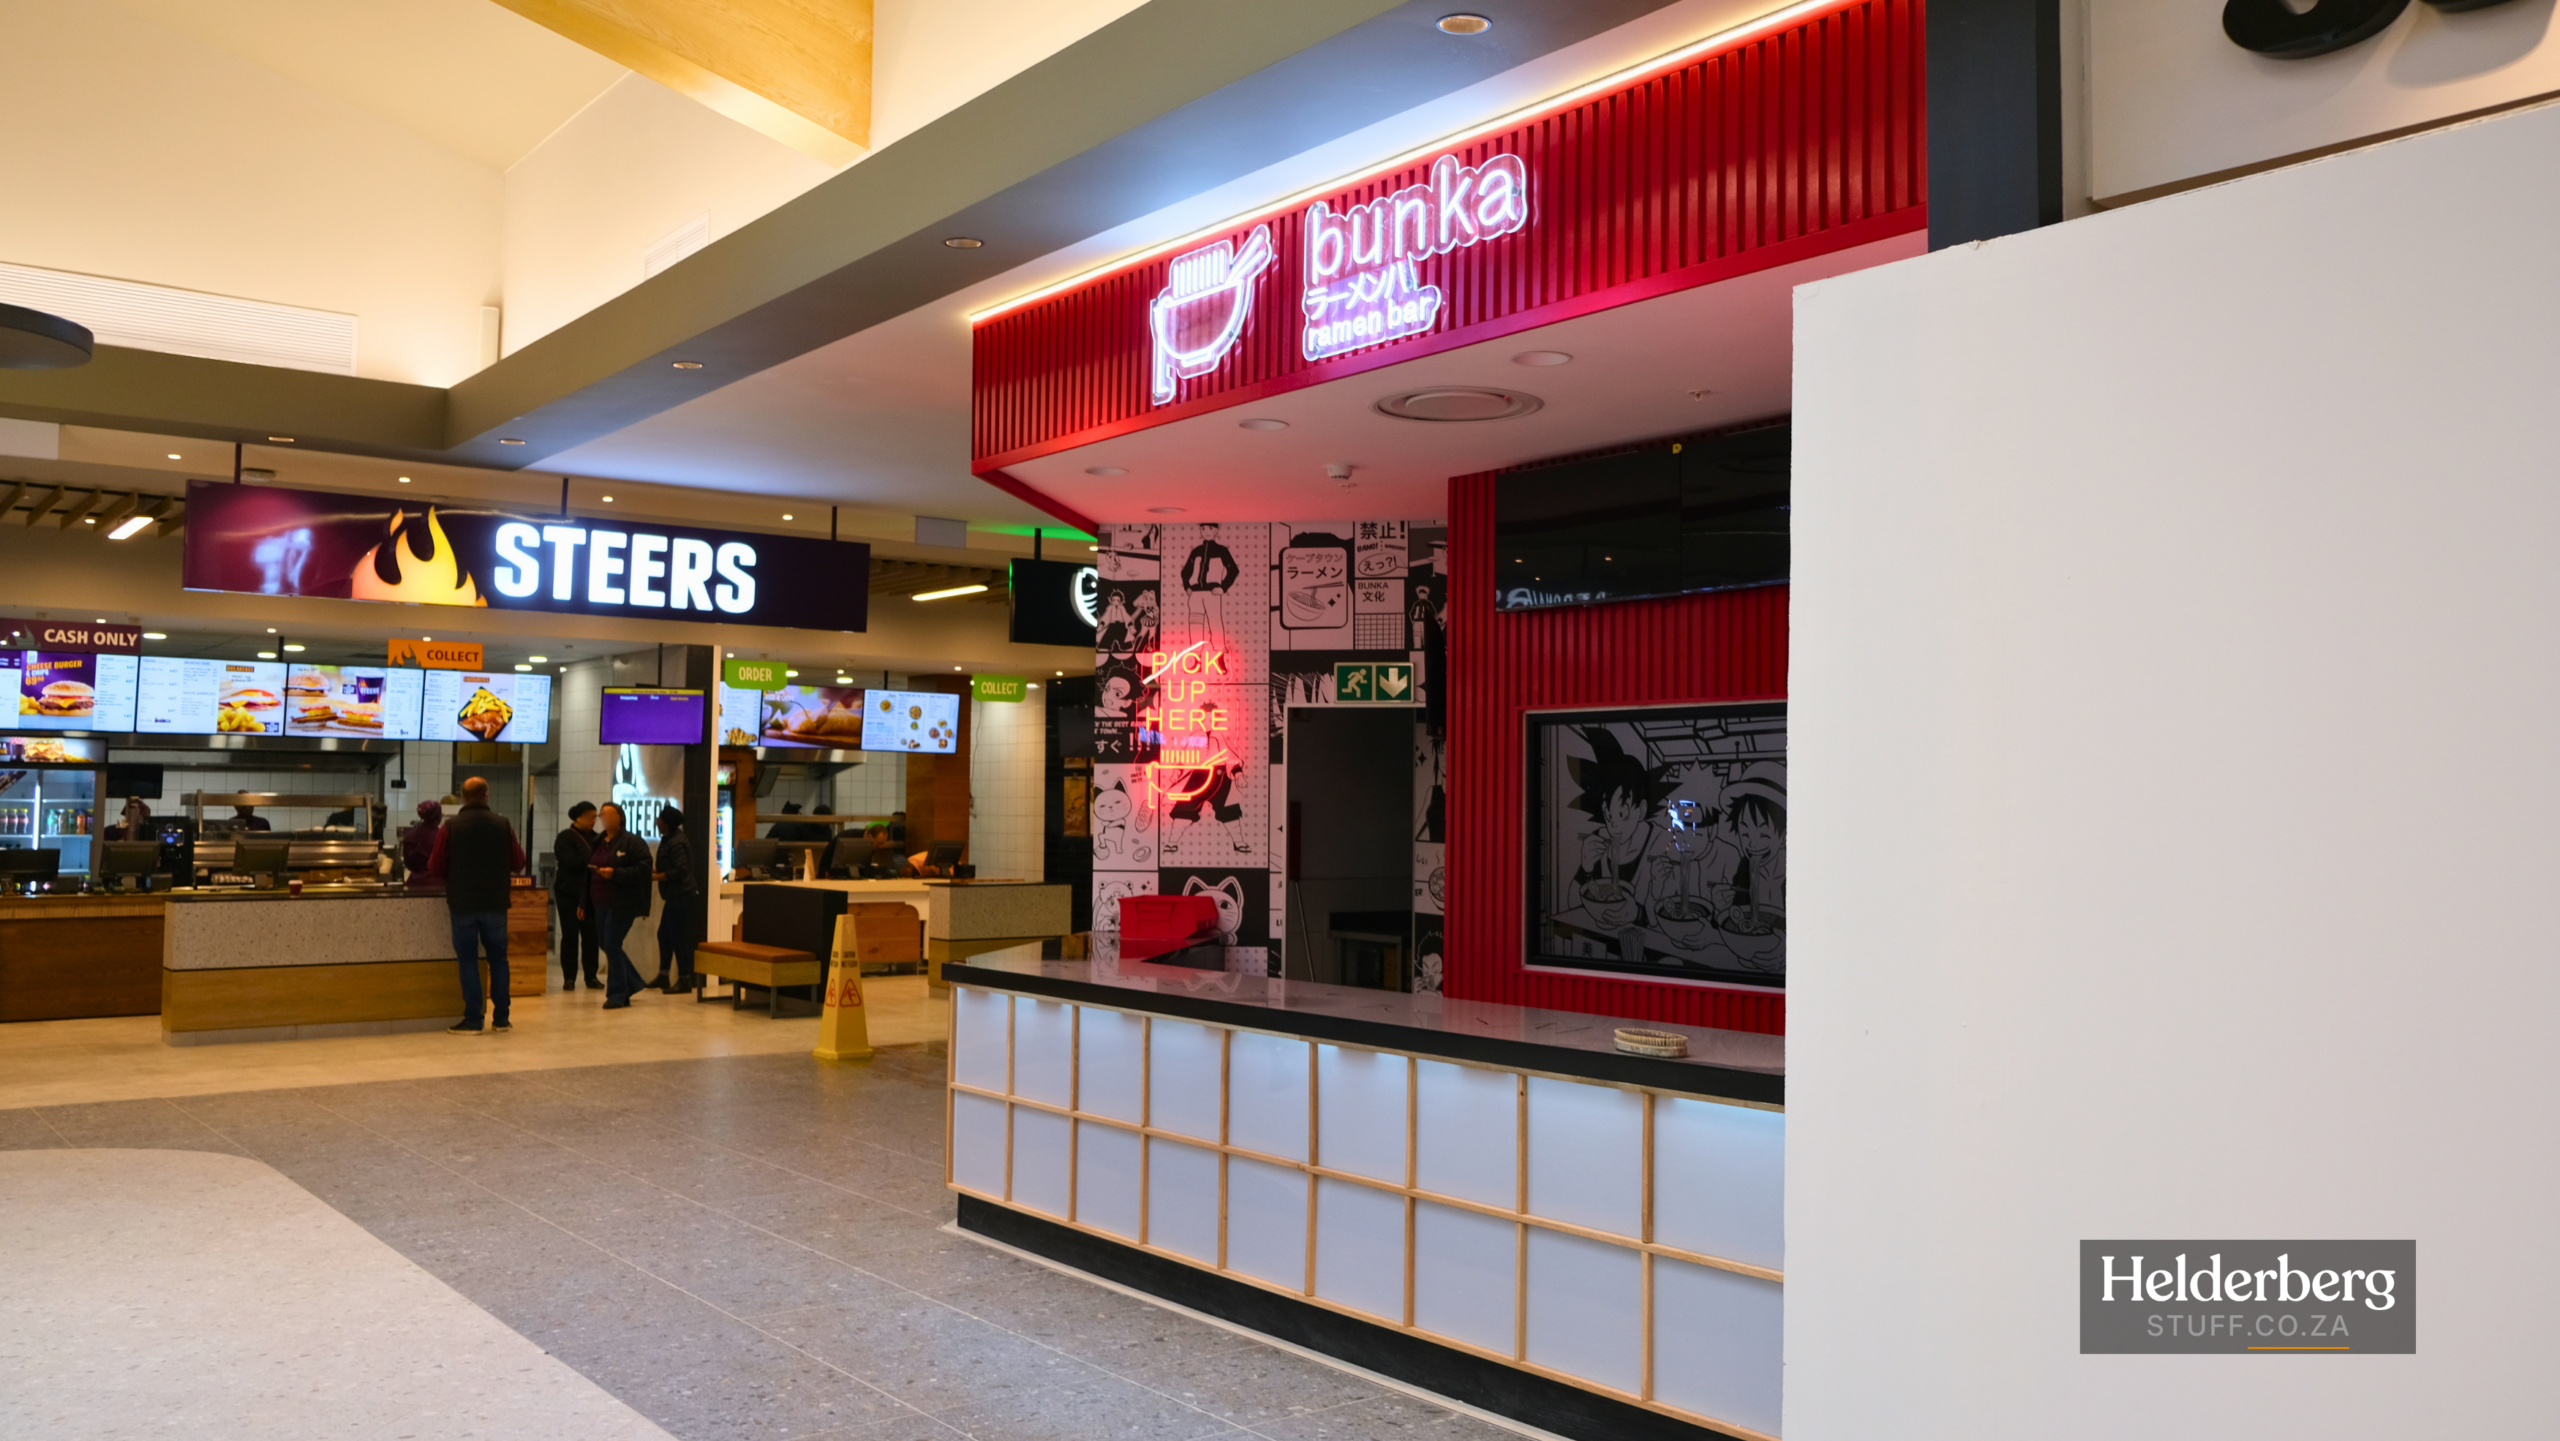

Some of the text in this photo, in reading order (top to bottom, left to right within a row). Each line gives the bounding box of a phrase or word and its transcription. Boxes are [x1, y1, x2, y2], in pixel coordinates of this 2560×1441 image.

[1312, 164, 1517, 286] bunka
[1308, 295, 1436, 352] ramen bar
[493, 522, 757, 614] STEERS
[1287, 566, 1343, 580] ラーメン
[1357, 582, 1389, 590] BUNKA
[1362, 591, 1386, 603] 文化
[44, 628, 138, 647] CASH ONLY
[426, 649, 480, 663] COLLECT
[1151, 650, 1224, 676] PICK
[54, 660, 83, 669] BURGER
[738, 666, 773, 682] ORDER
[981, 681, 1019, 695] COLLECT
[1167, 679, 1207, 704] UP
[1101, 720, 1113, 728] THE
[1113, 720, 1129, 728] BEST
[1145, 706, 1229, 732] HERE
